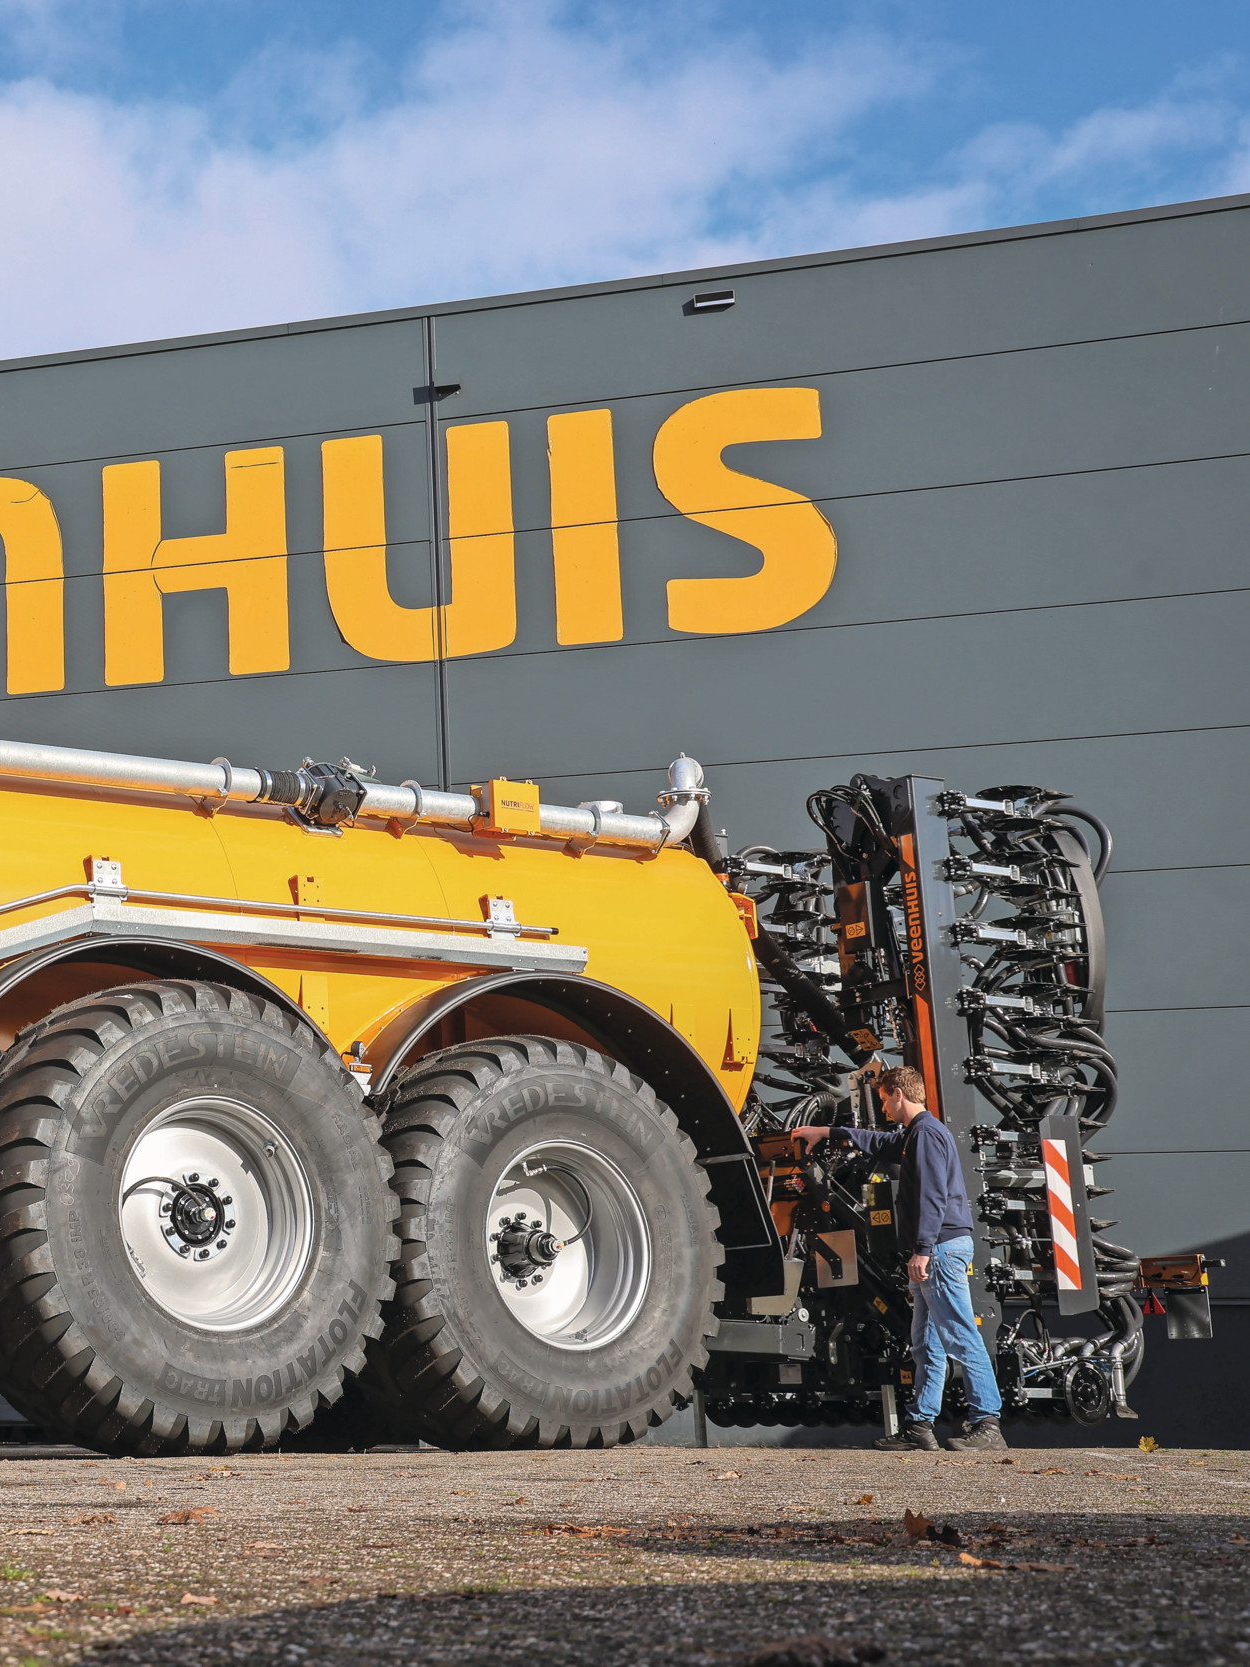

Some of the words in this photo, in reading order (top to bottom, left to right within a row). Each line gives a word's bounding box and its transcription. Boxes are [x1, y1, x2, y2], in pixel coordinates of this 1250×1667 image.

[501, 800, 534, 810] NUTRIFLOW
[77, 1030, 291, 1140] VREDESTEIN
[468, 1082, 654, 1147] VREDESTEIN
[68, 1210, 83, 1242] IMP
[231, 1279, 368, 1407] FLOTATION
[164, 1371, 226, 1405] TRAC
[550, 1338, 684, 1415] FLOTATION
